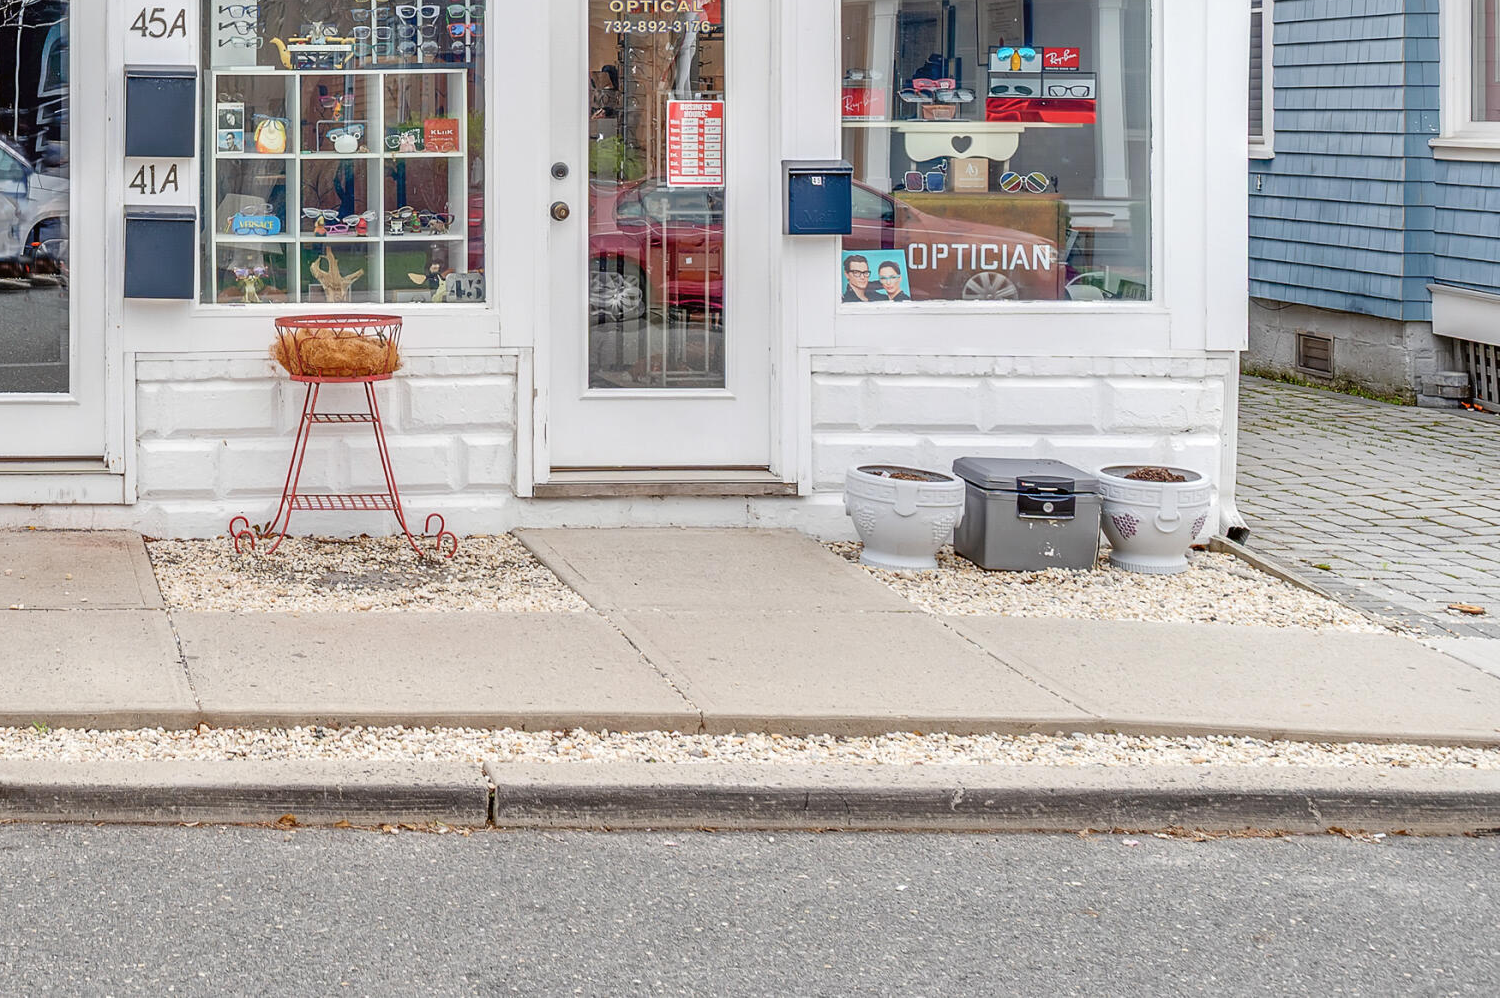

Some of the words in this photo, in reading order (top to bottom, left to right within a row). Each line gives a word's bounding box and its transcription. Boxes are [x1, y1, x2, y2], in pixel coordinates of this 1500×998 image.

[609, 0, 705, 13] OPTICAL
[129, 6, 187, 39] 45A
[603, 20, 711, 34] 732-892-3176
[129, 163, 179, 194] 41A
[908, 242, 1051, 271] OPTICIAN
